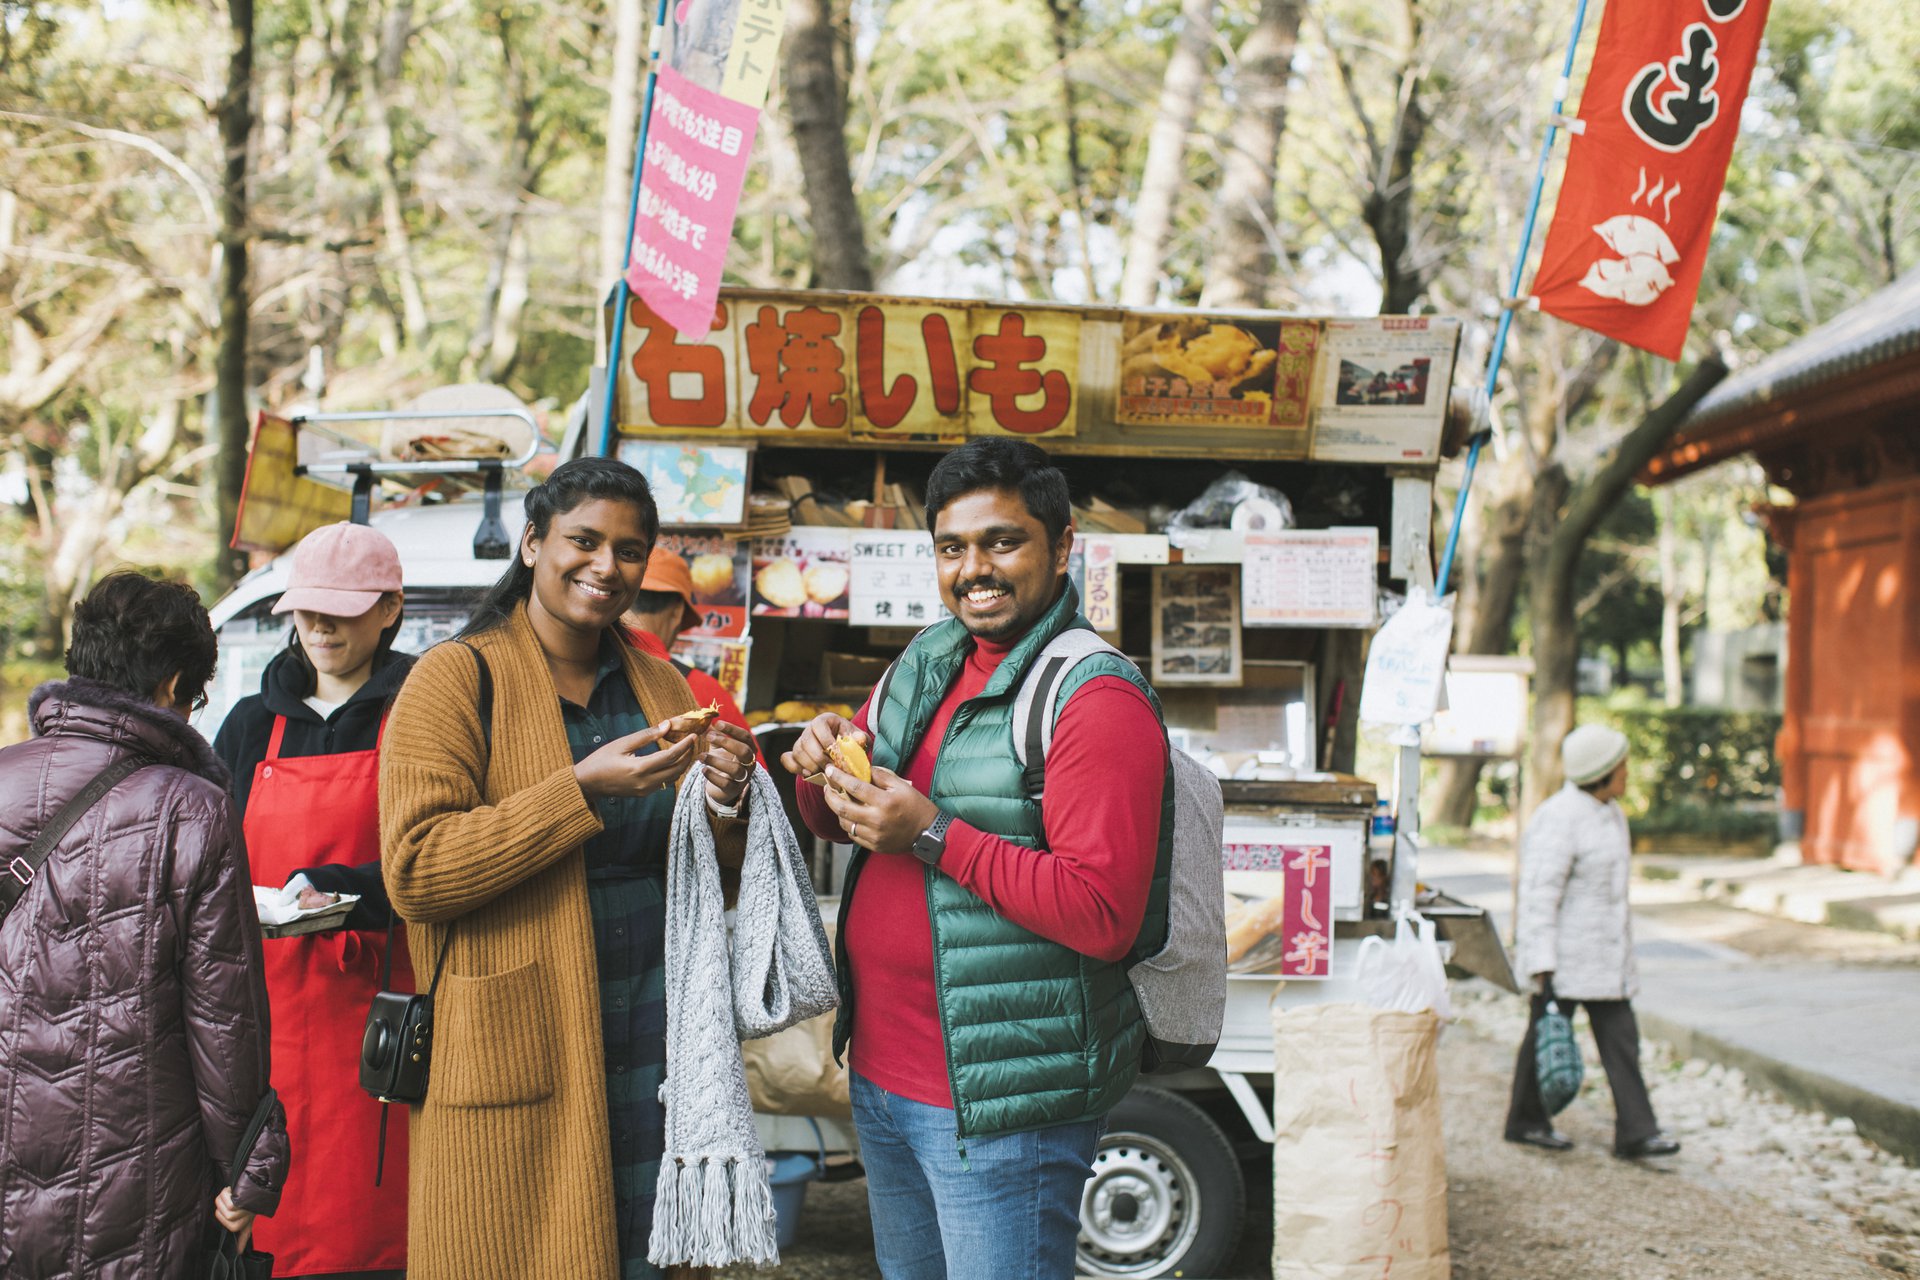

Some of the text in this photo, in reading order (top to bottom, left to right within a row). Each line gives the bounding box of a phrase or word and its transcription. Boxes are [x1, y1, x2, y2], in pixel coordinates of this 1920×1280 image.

[630, 299, 1071, 433] 石焼いも
[853, 542, 906, 558] SWEET
[84, 753, 158, 801] HARLES
[1284, 846, 1331, 975] 干し芋
